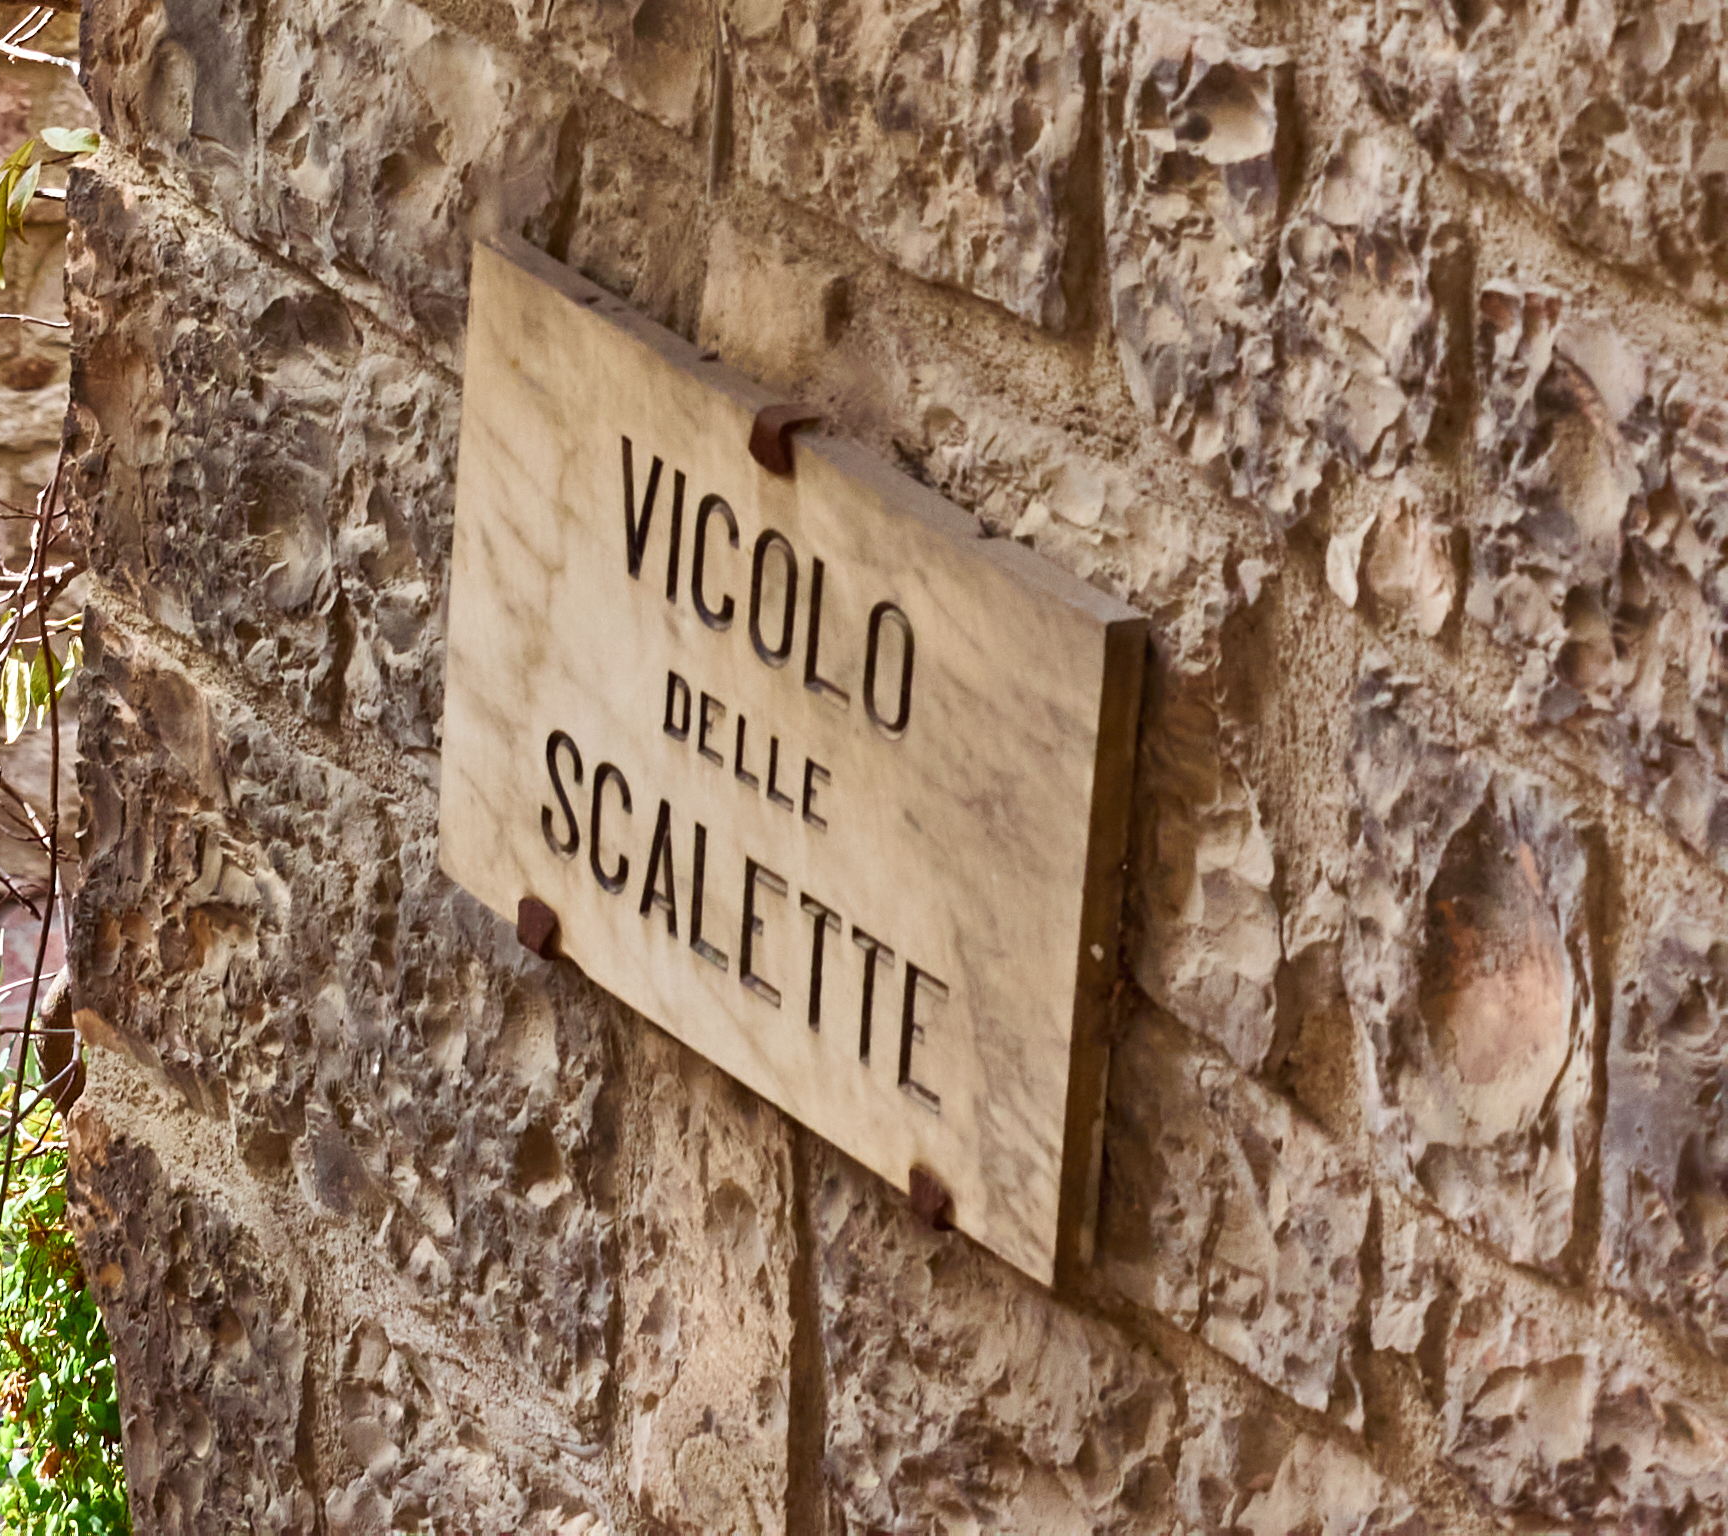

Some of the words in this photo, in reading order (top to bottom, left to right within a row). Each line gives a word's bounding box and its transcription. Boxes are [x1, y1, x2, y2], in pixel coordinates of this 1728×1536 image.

[620, 436, 916, 739] VICOLO
[664, 670, 832, 831] DELLE
[541, 729, 949, 1113] SCALETTE
